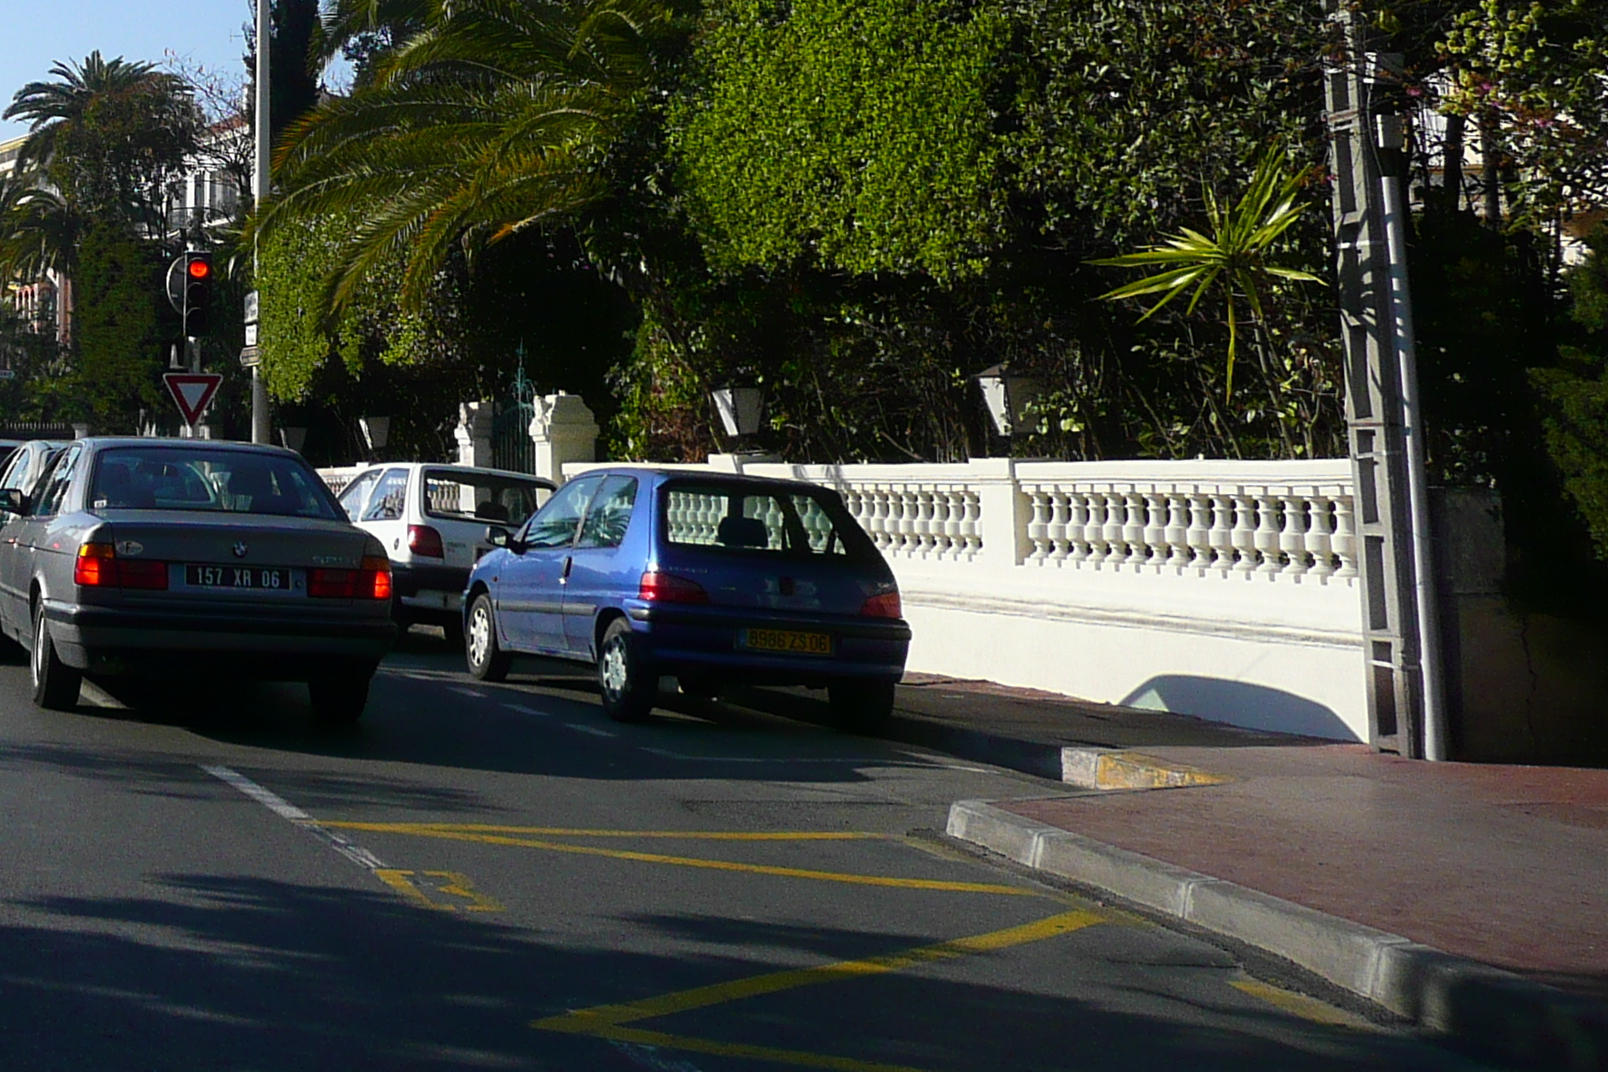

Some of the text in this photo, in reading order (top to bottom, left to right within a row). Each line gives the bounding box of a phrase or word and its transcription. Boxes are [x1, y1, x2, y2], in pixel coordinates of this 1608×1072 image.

[196, 566, 281, 588] 157 XR 06
[748, 630, 829, 652] 8986 ZS 06
